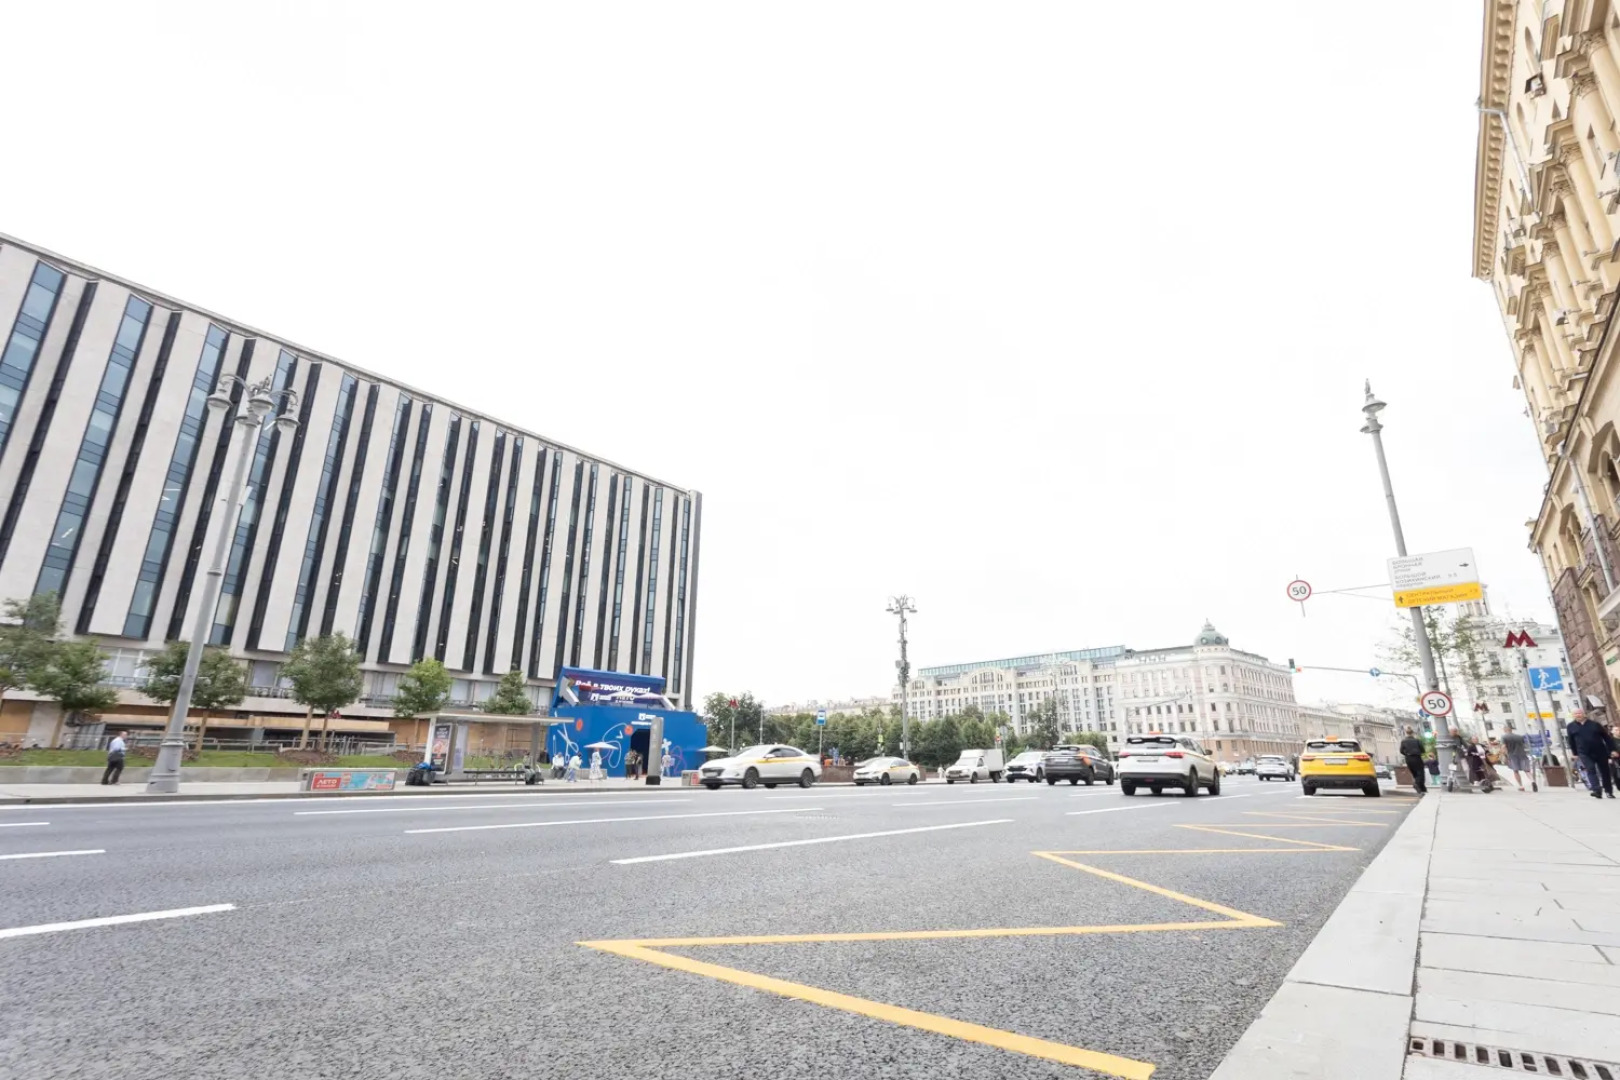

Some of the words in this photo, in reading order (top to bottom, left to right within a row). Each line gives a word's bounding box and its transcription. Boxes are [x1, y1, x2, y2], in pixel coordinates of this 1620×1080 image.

[1292, 585, 1307, 596] 50
[1502, 629, 1538, 648] М
[1428, 698, 1446, 710] 50
